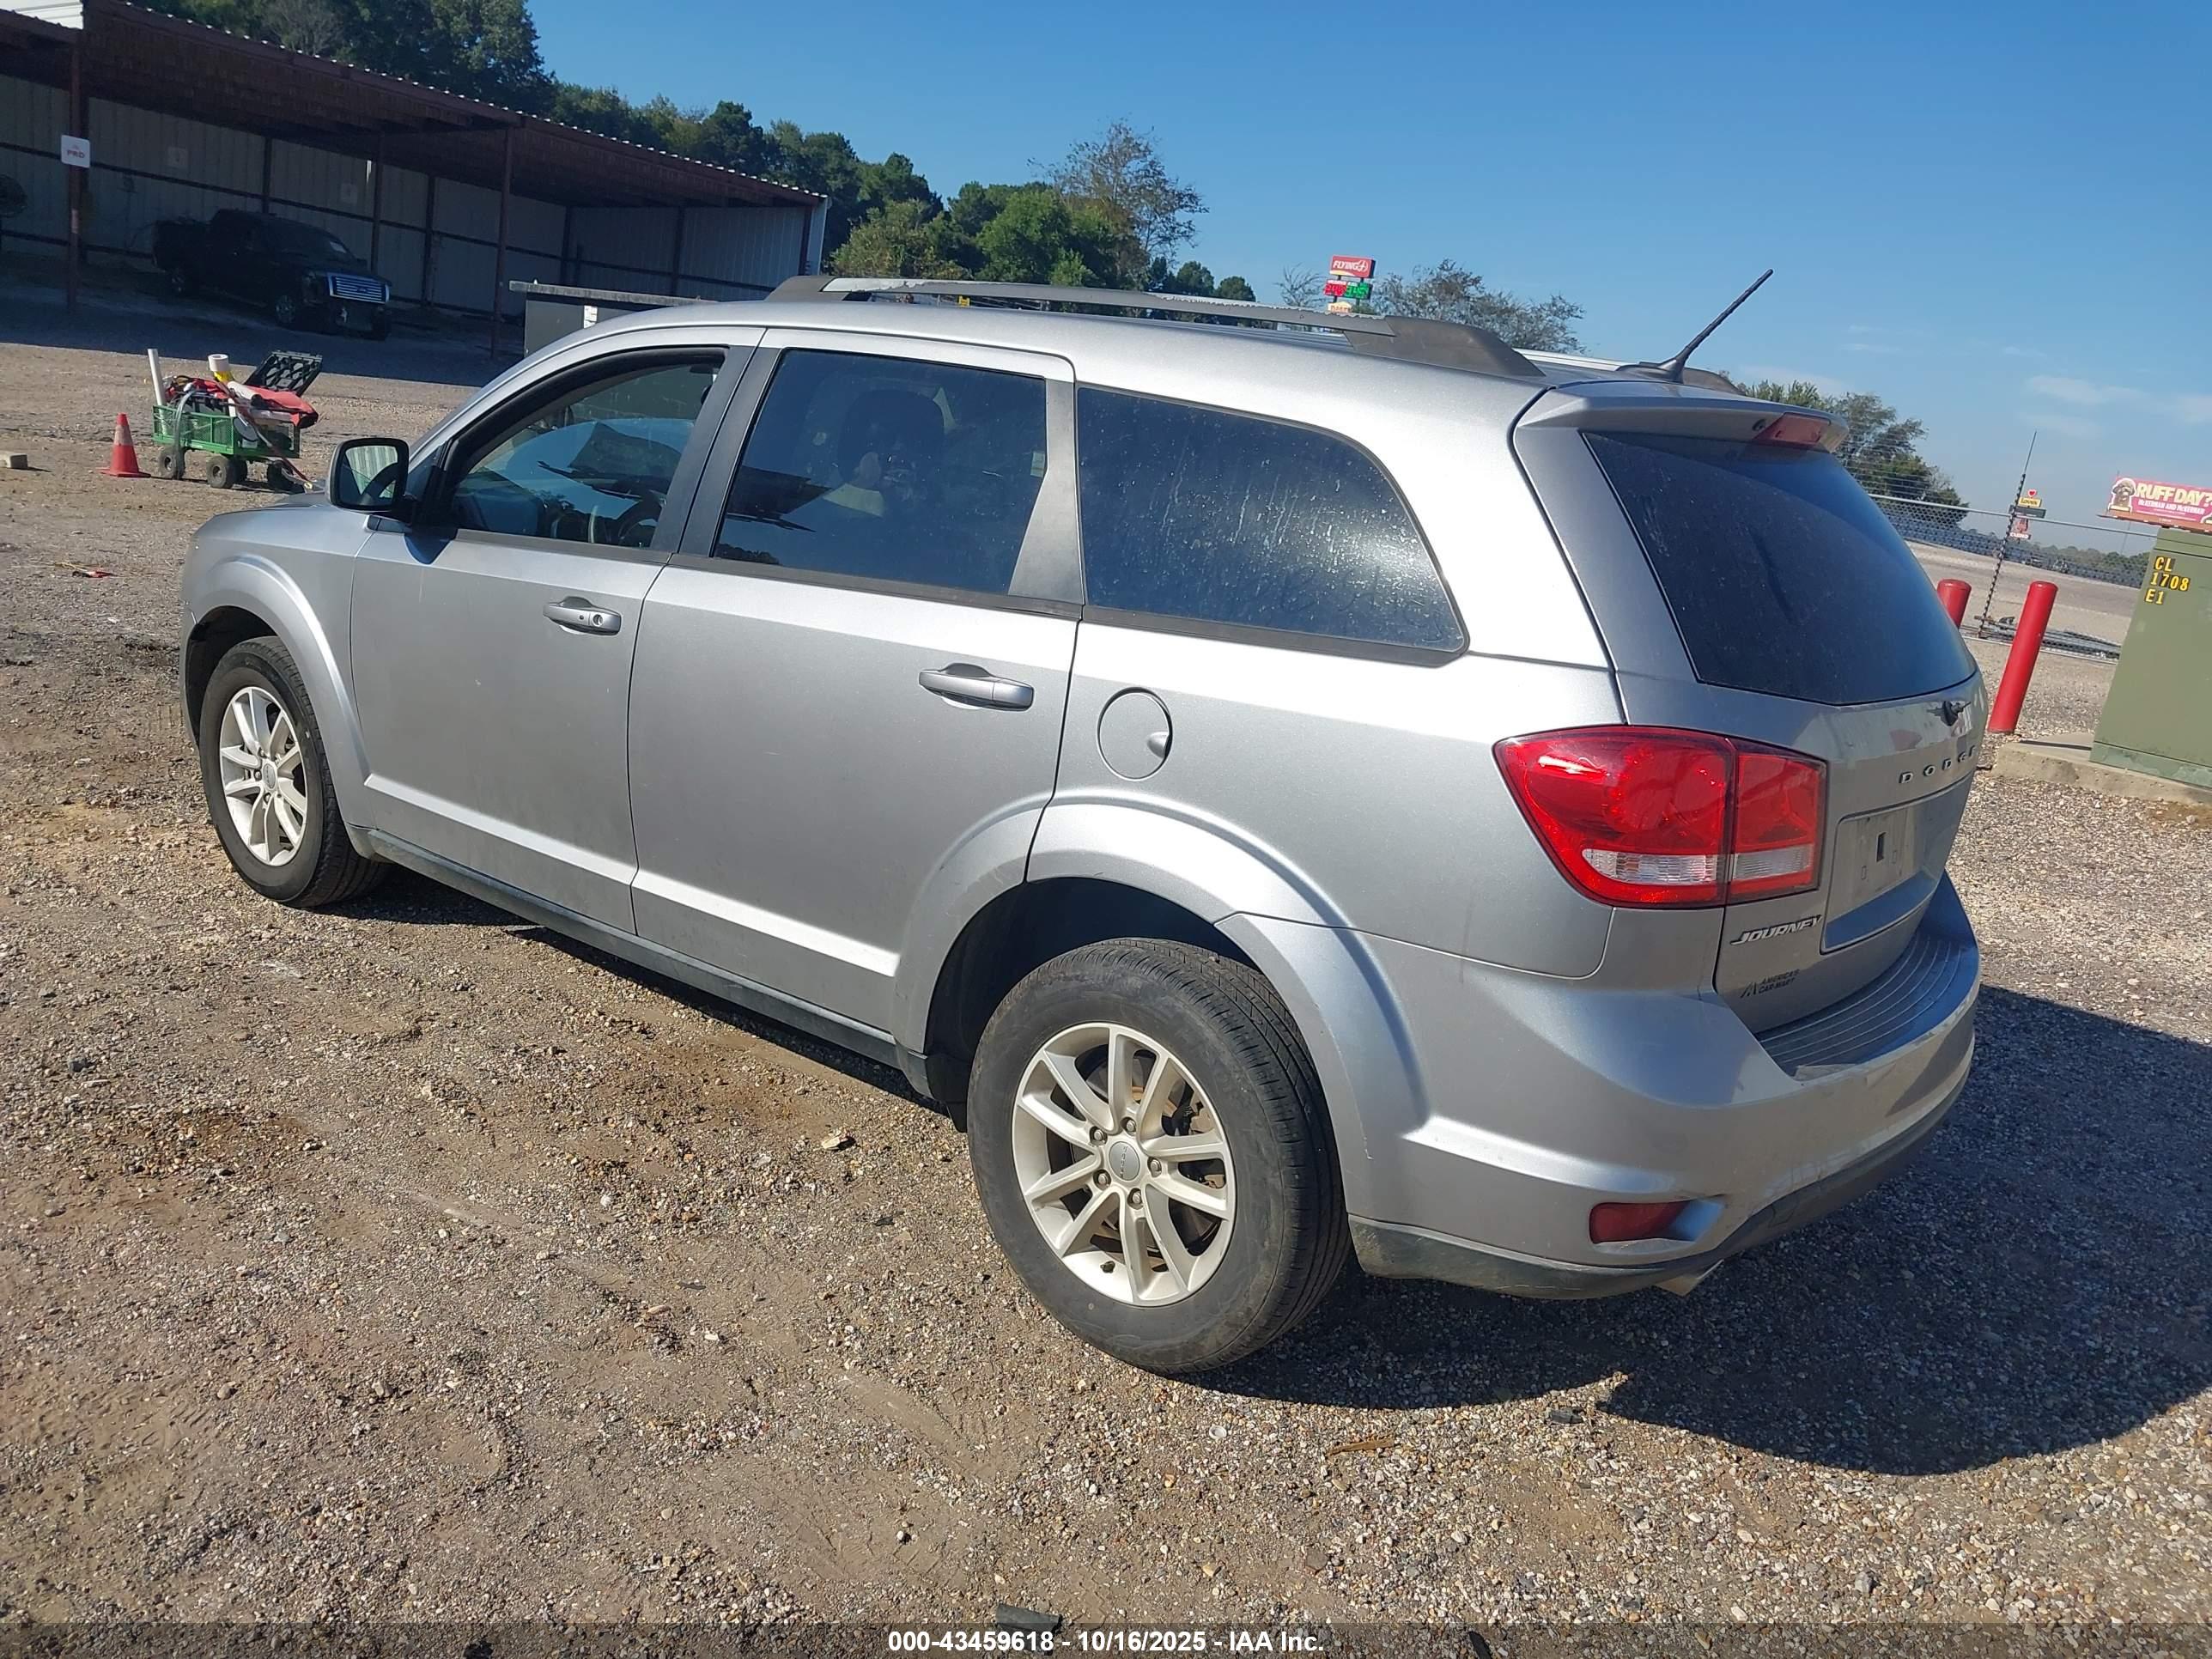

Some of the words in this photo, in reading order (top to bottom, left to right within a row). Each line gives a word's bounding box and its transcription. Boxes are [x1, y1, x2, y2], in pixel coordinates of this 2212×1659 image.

[2135, 483, 2176, 501] RUFF
[2173, 488, 2212, 507] DAY?
[2154, 556, 2172, 572] CL
[2150, 572, 2189, 591] 1708
[2145, 588, 2164, 605] E1
[1729, 915, 1822, 945] JOURNEY
